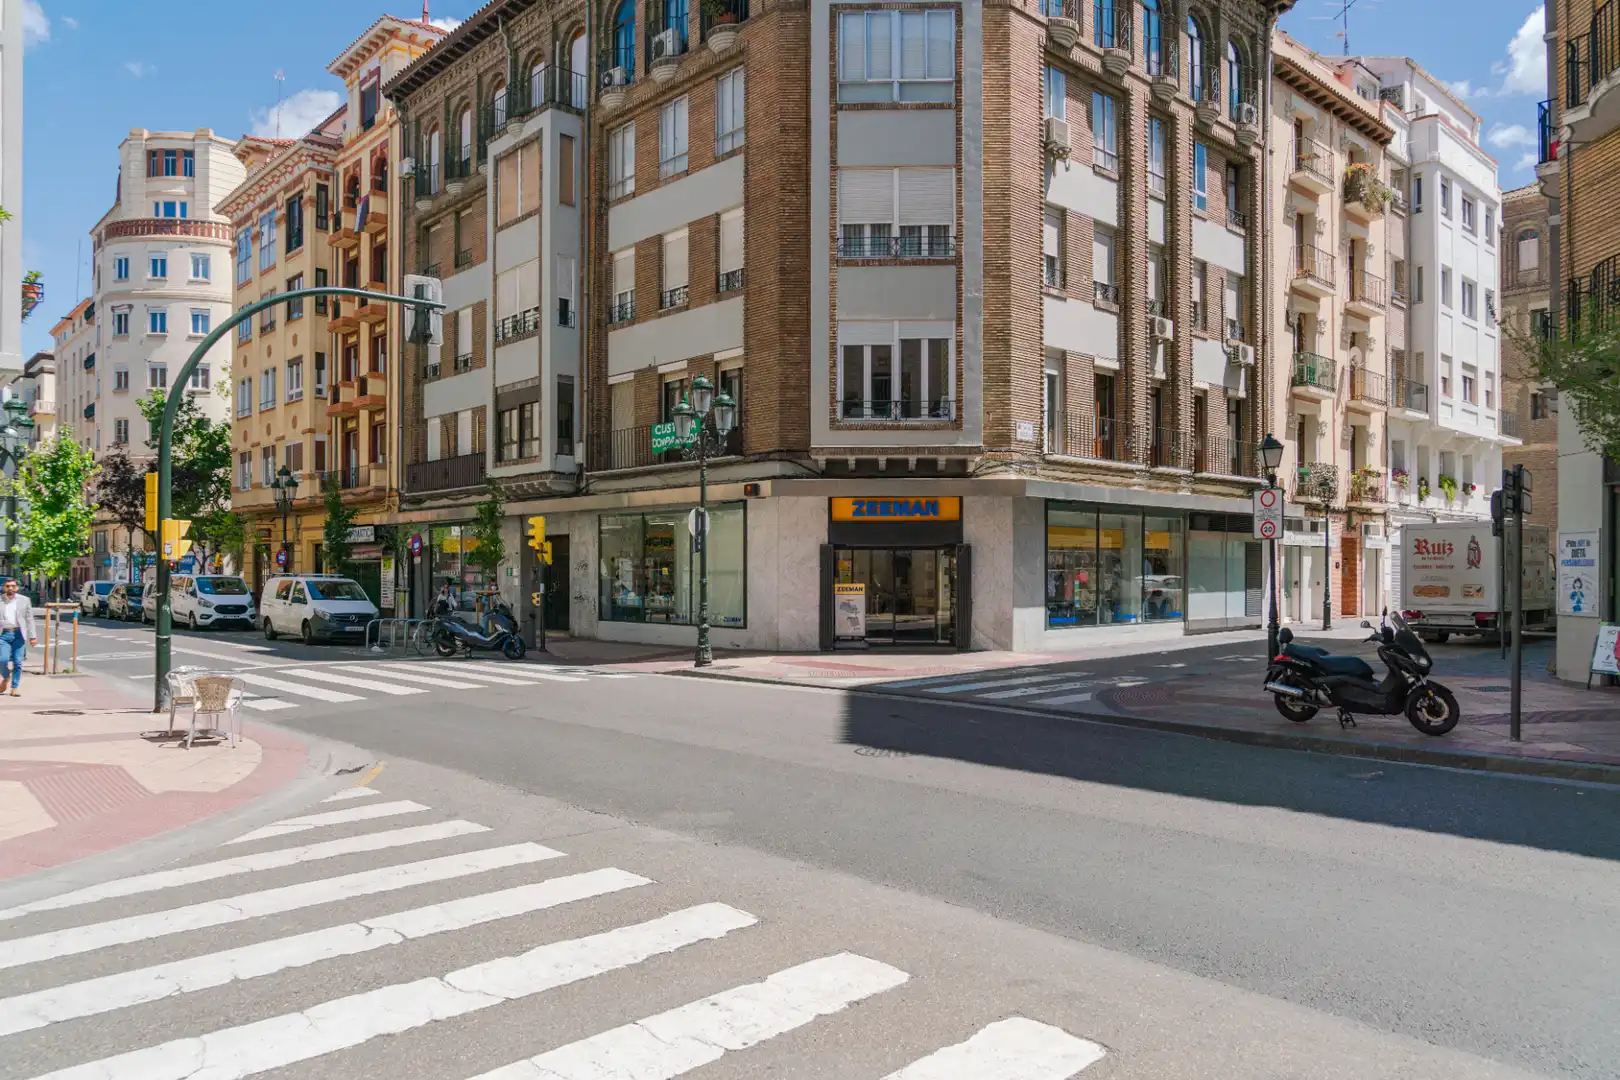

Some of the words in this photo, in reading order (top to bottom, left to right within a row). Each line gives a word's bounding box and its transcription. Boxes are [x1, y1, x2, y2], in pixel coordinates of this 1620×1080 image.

[655, 420, 697, 435] CUSTA
[852, 501, 939, 516] ZEEMAN
[1412, 538, 1454, 557] Ruiz
